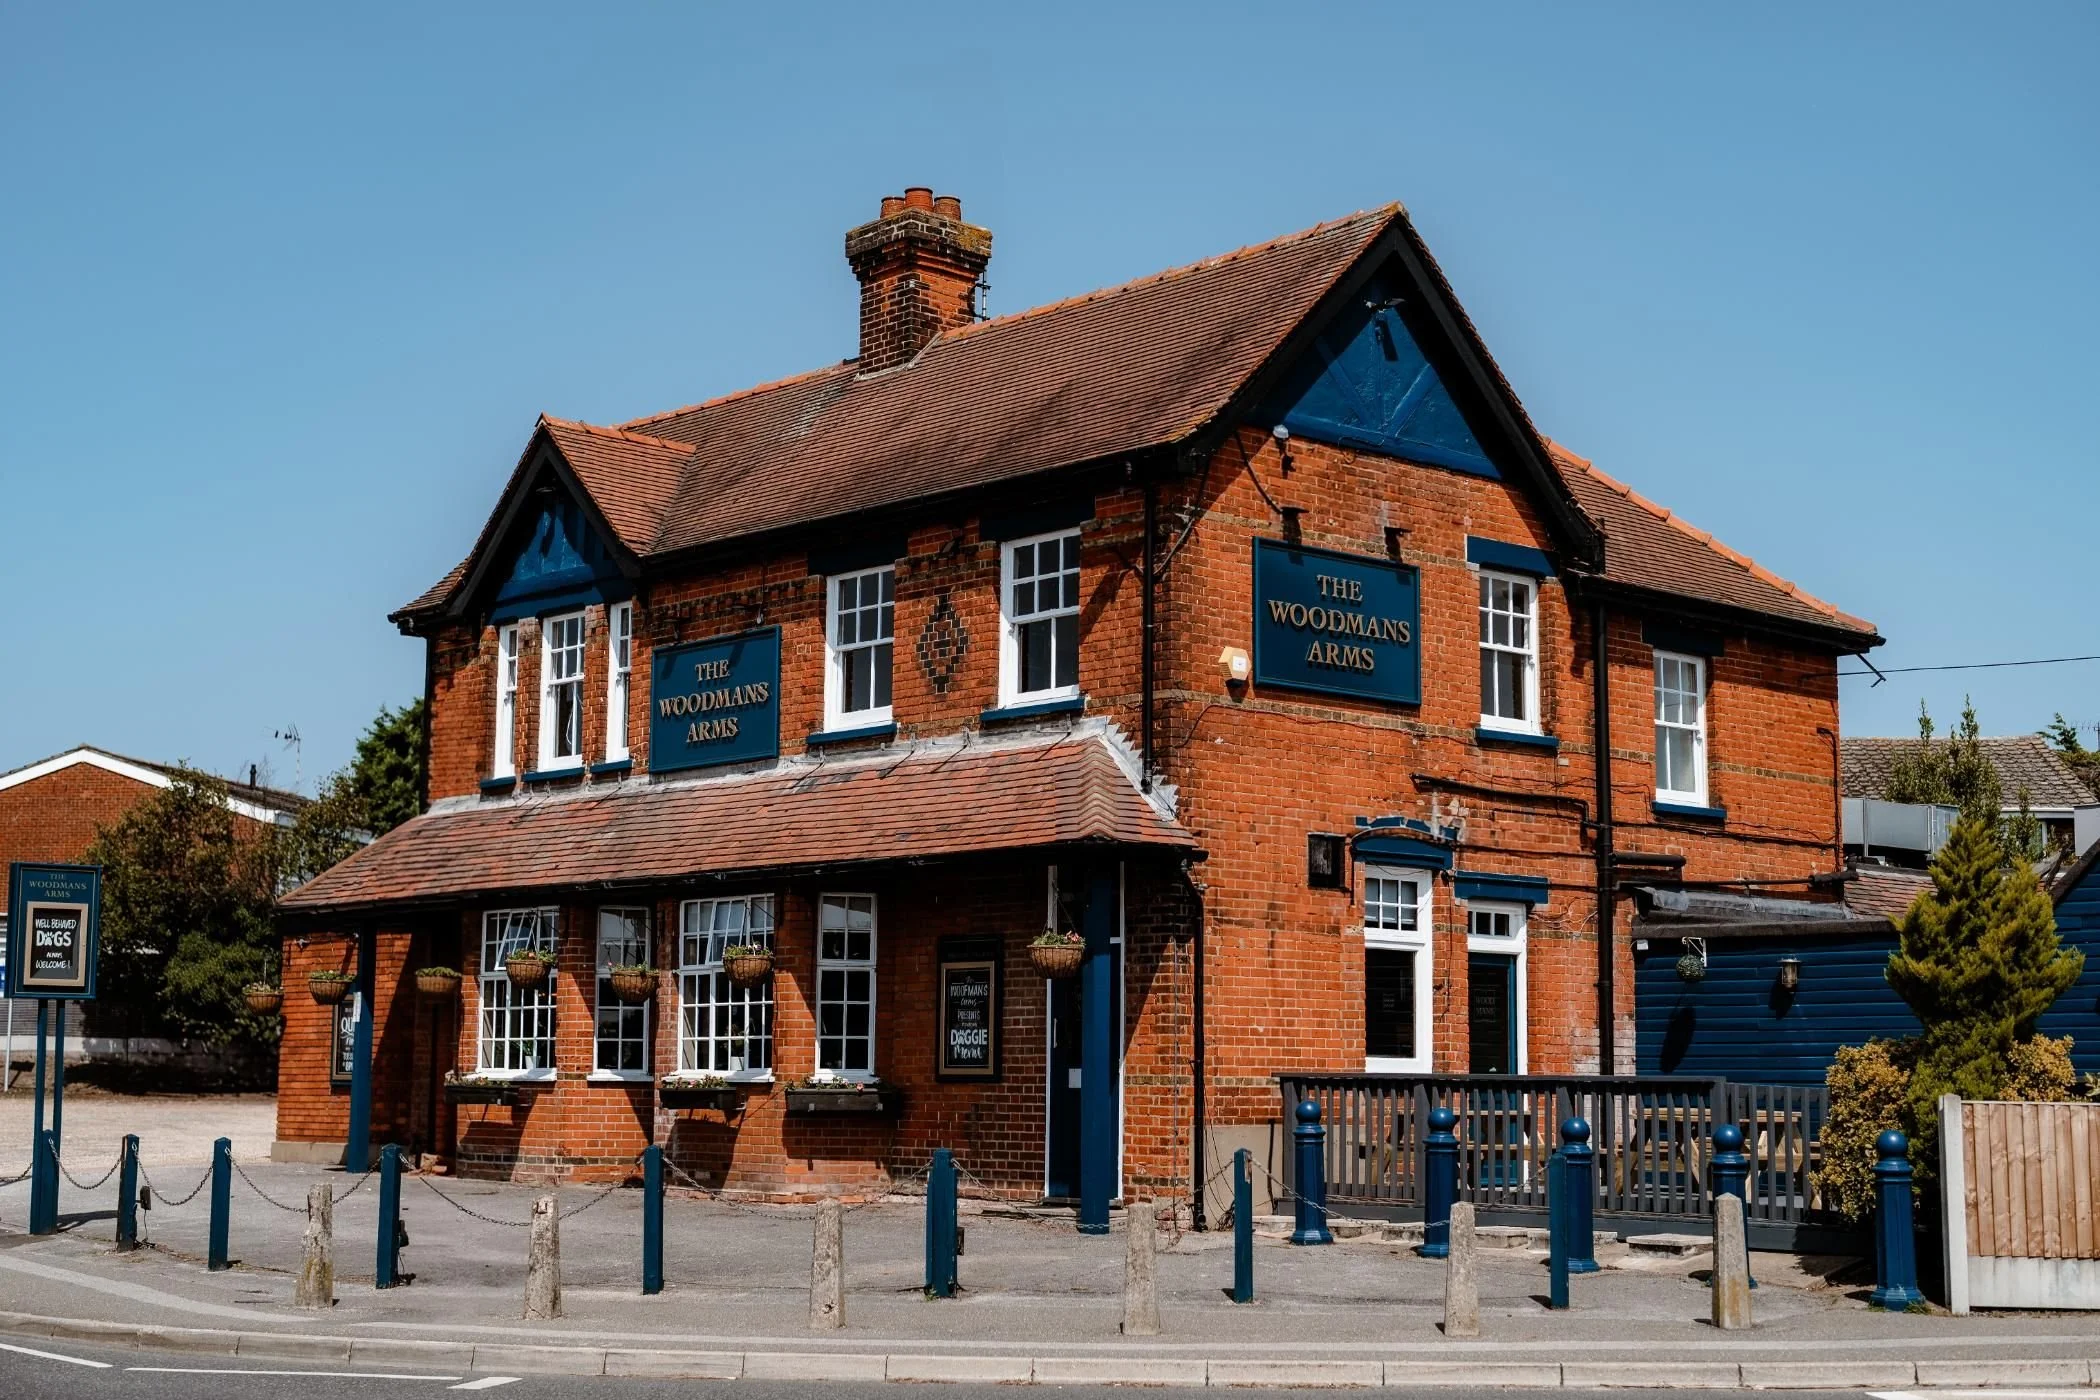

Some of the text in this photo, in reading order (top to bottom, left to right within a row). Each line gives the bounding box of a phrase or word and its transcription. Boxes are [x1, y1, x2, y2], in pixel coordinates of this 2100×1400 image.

[1316, 574, 1364, 602] THE
[1267, 599, 1410, 644] WOODMANS
[1307, 640, 1375, 671] ARMS
[694, 659, 730, 682] THE
[658, 681, 770, 718] WOODMANS
[686, 717, 739, 743] ARMS
[28, 880, 87, 890] WOODMANS
[44, 890, 71, 898] ARMS
[35, 918, 77, 930] WELL BEHAVED
[950, 983, 988, 997] WOOFMANS
